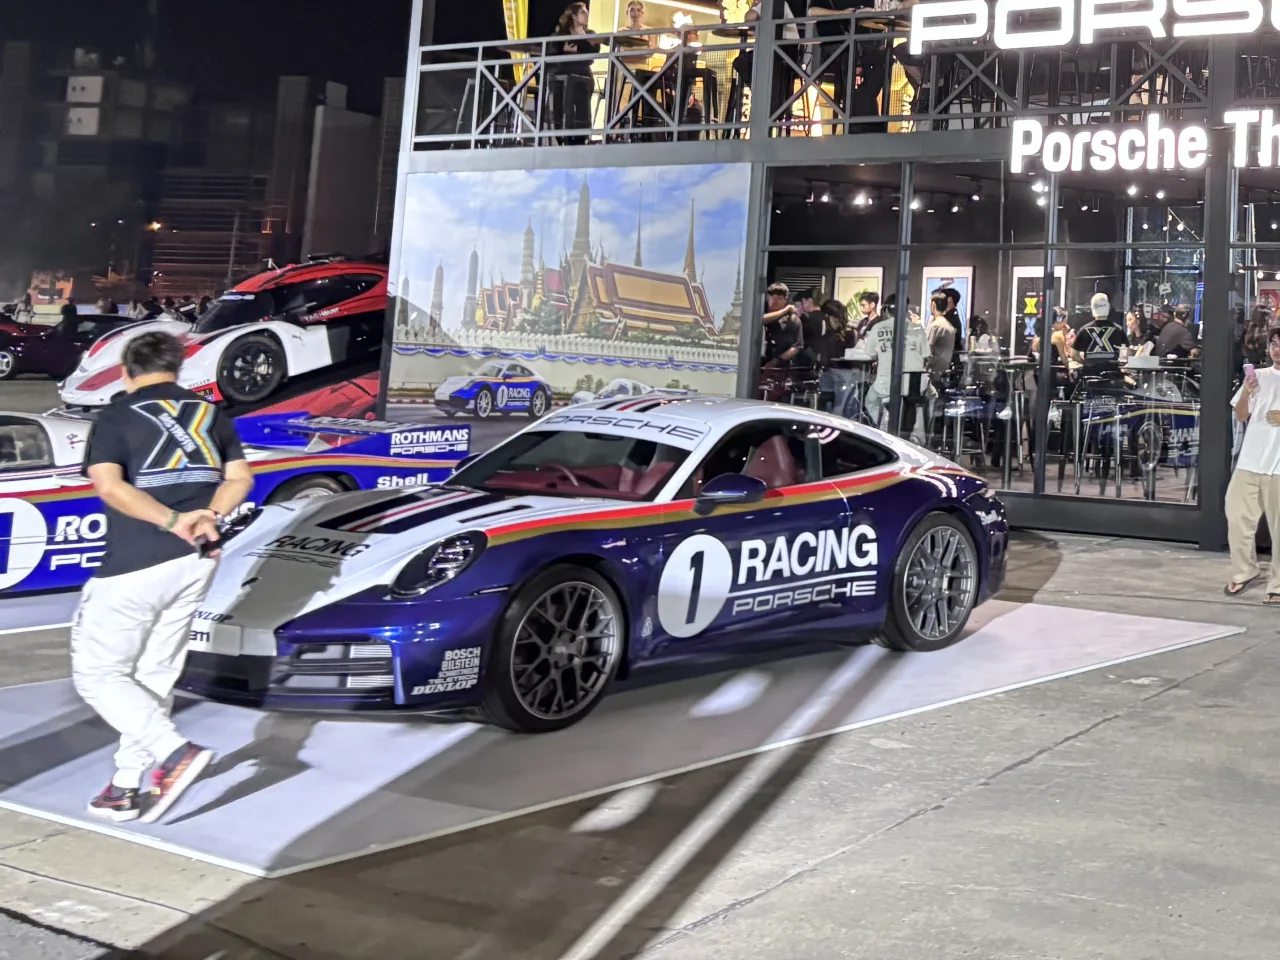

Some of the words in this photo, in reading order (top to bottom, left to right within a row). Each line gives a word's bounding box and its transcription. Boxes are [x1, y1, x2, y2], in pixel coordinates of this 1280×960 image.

[1011, 113, 1208, 174] Porsche
[508, 387, 531, 399] RACING
[390, 428, 469, 445] ROTHMANS
[543, 415, 704, 441] ORSCHE
[390, 443, 468, 456] PORSCHE
[377, 472, 428, 489] Shell
[264, 535, 371, 558] RACING
[685, 551, 705, 625] 1
[737, 524, 878, 585] RACING
[732, 581, 877, 616] PORSCHE
[193, 610, 235, 623] NLOP
[444, 646, 481, 661] BOSCH
[441, 656, 481, 671] BILSTEIN
[410, 679, 479, 696] DUNLOP
